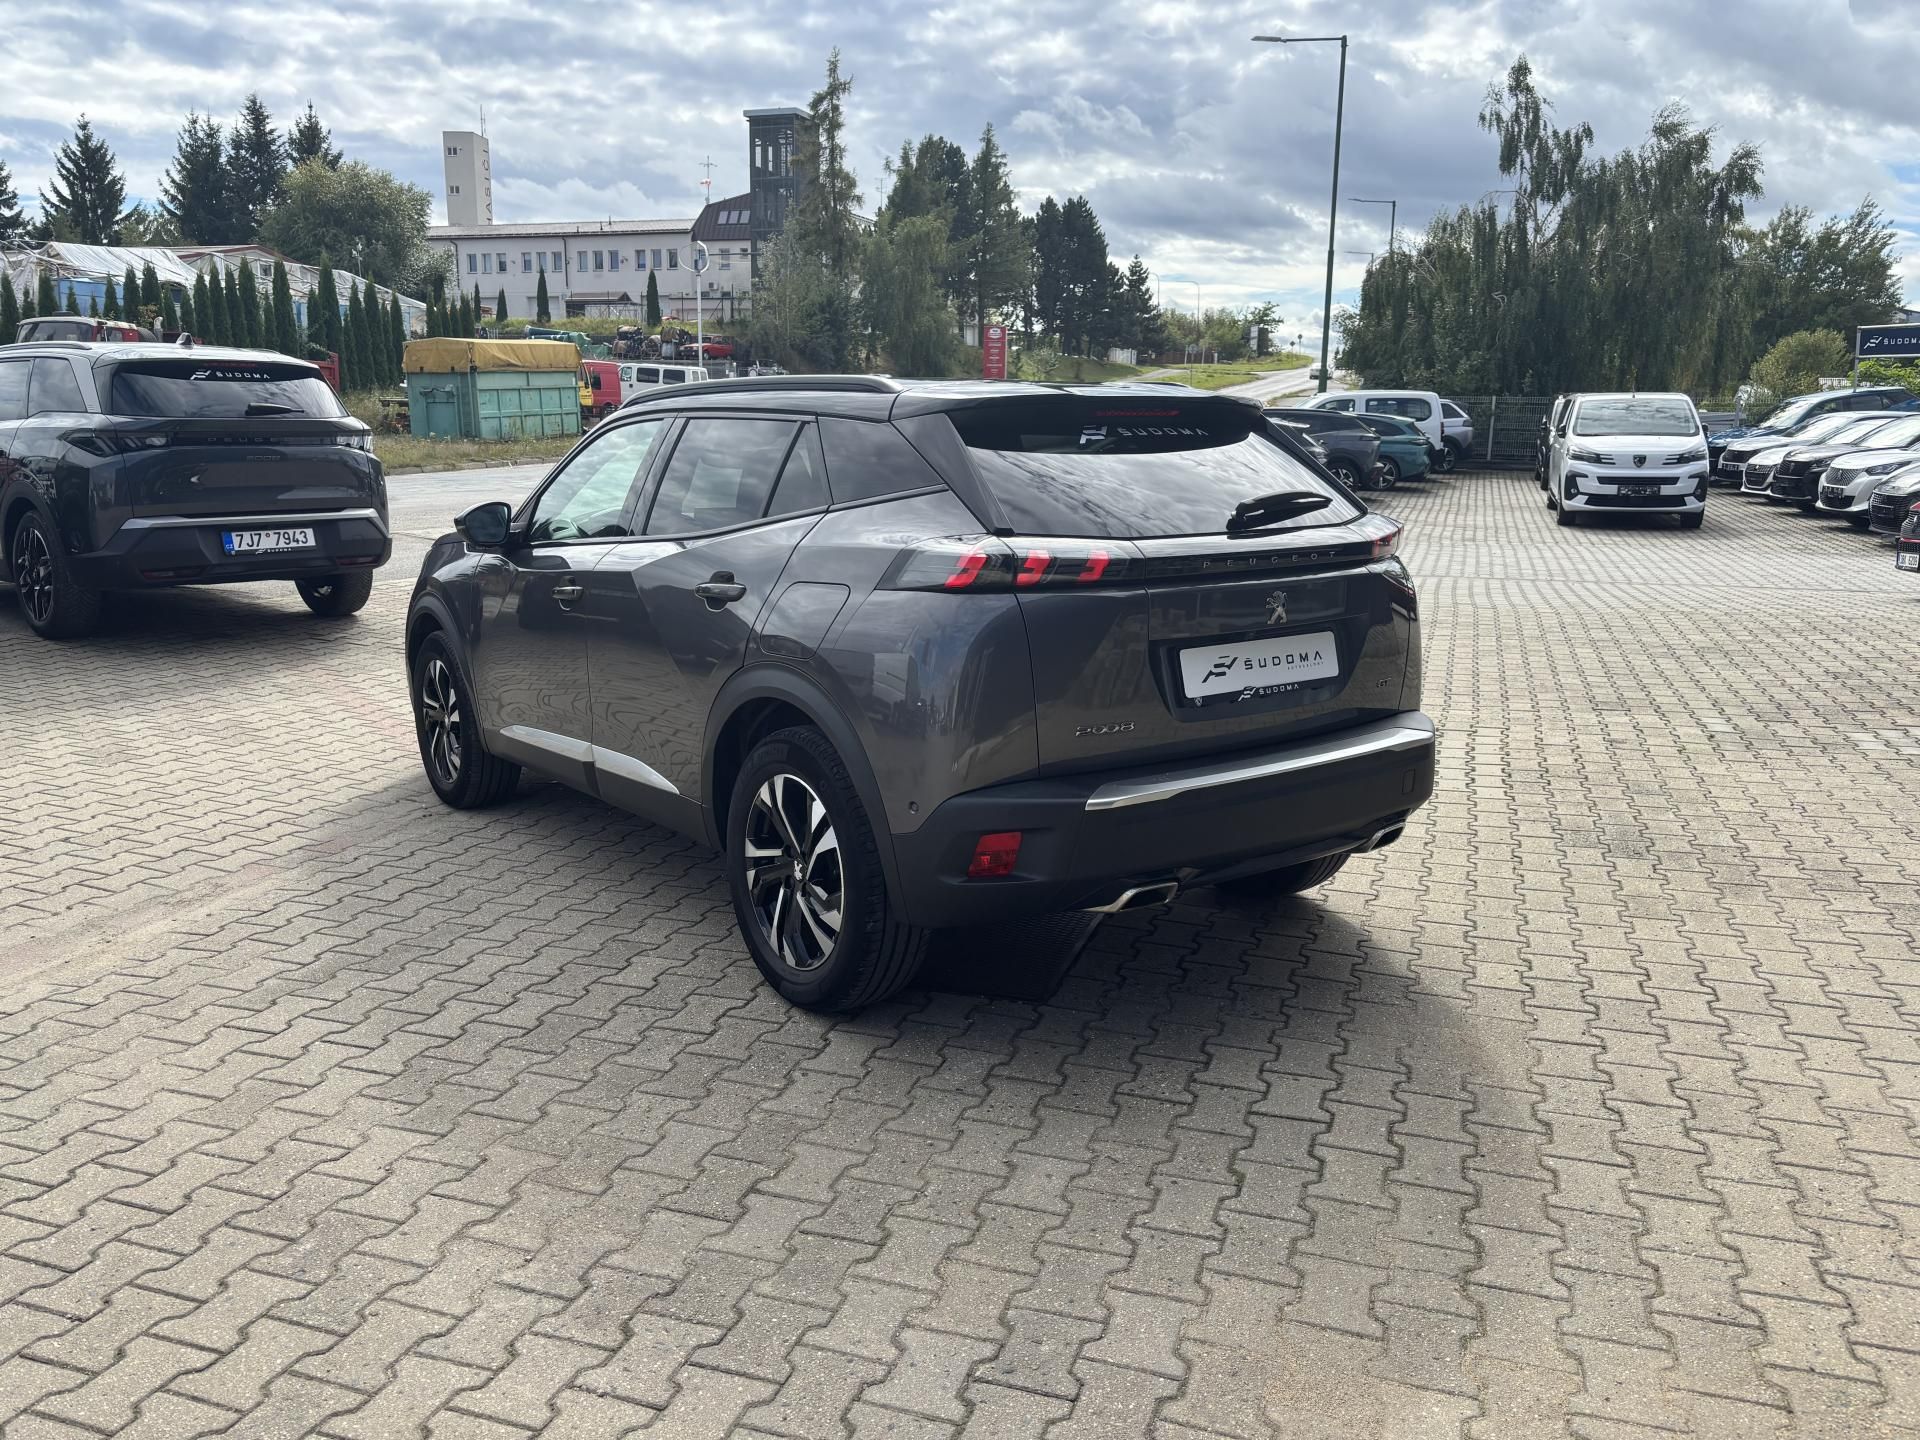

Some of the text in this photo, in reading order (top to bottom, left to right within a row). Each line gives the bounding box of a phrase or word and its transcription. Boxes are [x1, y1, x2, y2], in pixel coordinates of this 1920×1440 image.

[235, 530, 309, 548] 7J7 7943
[1203, 551, 1336, 569] PEUGEOT
[1075, 721, 1135, 737] 2008
